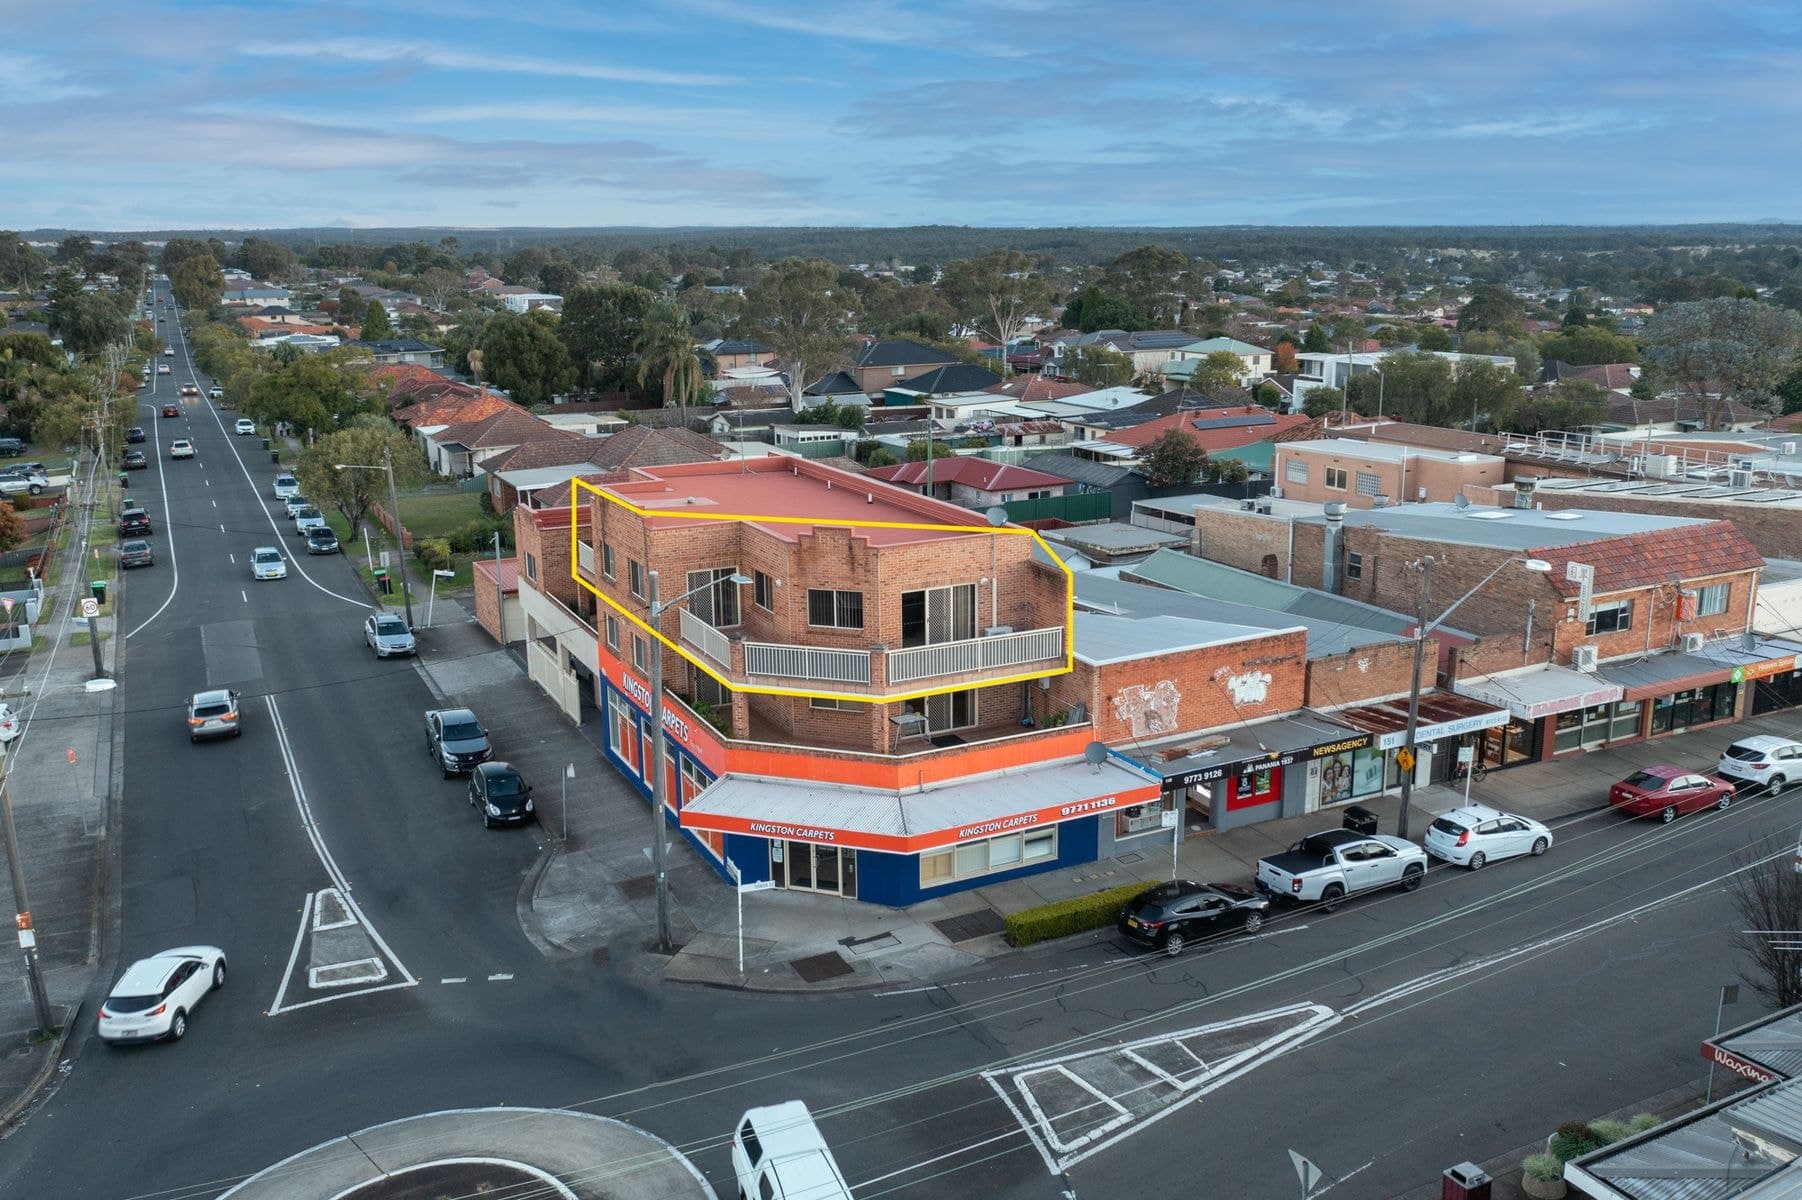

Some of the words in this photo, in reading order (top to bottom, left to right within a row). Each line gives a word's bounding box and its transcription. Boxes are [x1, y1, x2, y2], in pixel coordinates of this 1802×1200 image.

[622, 672, 652, 715] KINGSTO
[661, 706, 689, 742] ARPETS
[1416, 728, 1444, 740] DENTAL
[1447, 718, 1483, 733] SURGERY
[1312, 737, 1368, 757] NEWSAGENCY
[1383, 736, 1395, 746] 151
[1184, 775, 1203, 784] 9773
[1203, 769, 1223, 780] 9126
[750, 822, 794, 836] KINGSTON
[796, 828, 835, 841] CARPETS
[958, 820, 1001, 838] KINGSTON
[1002, 813, 1038, 829] CARPETS
